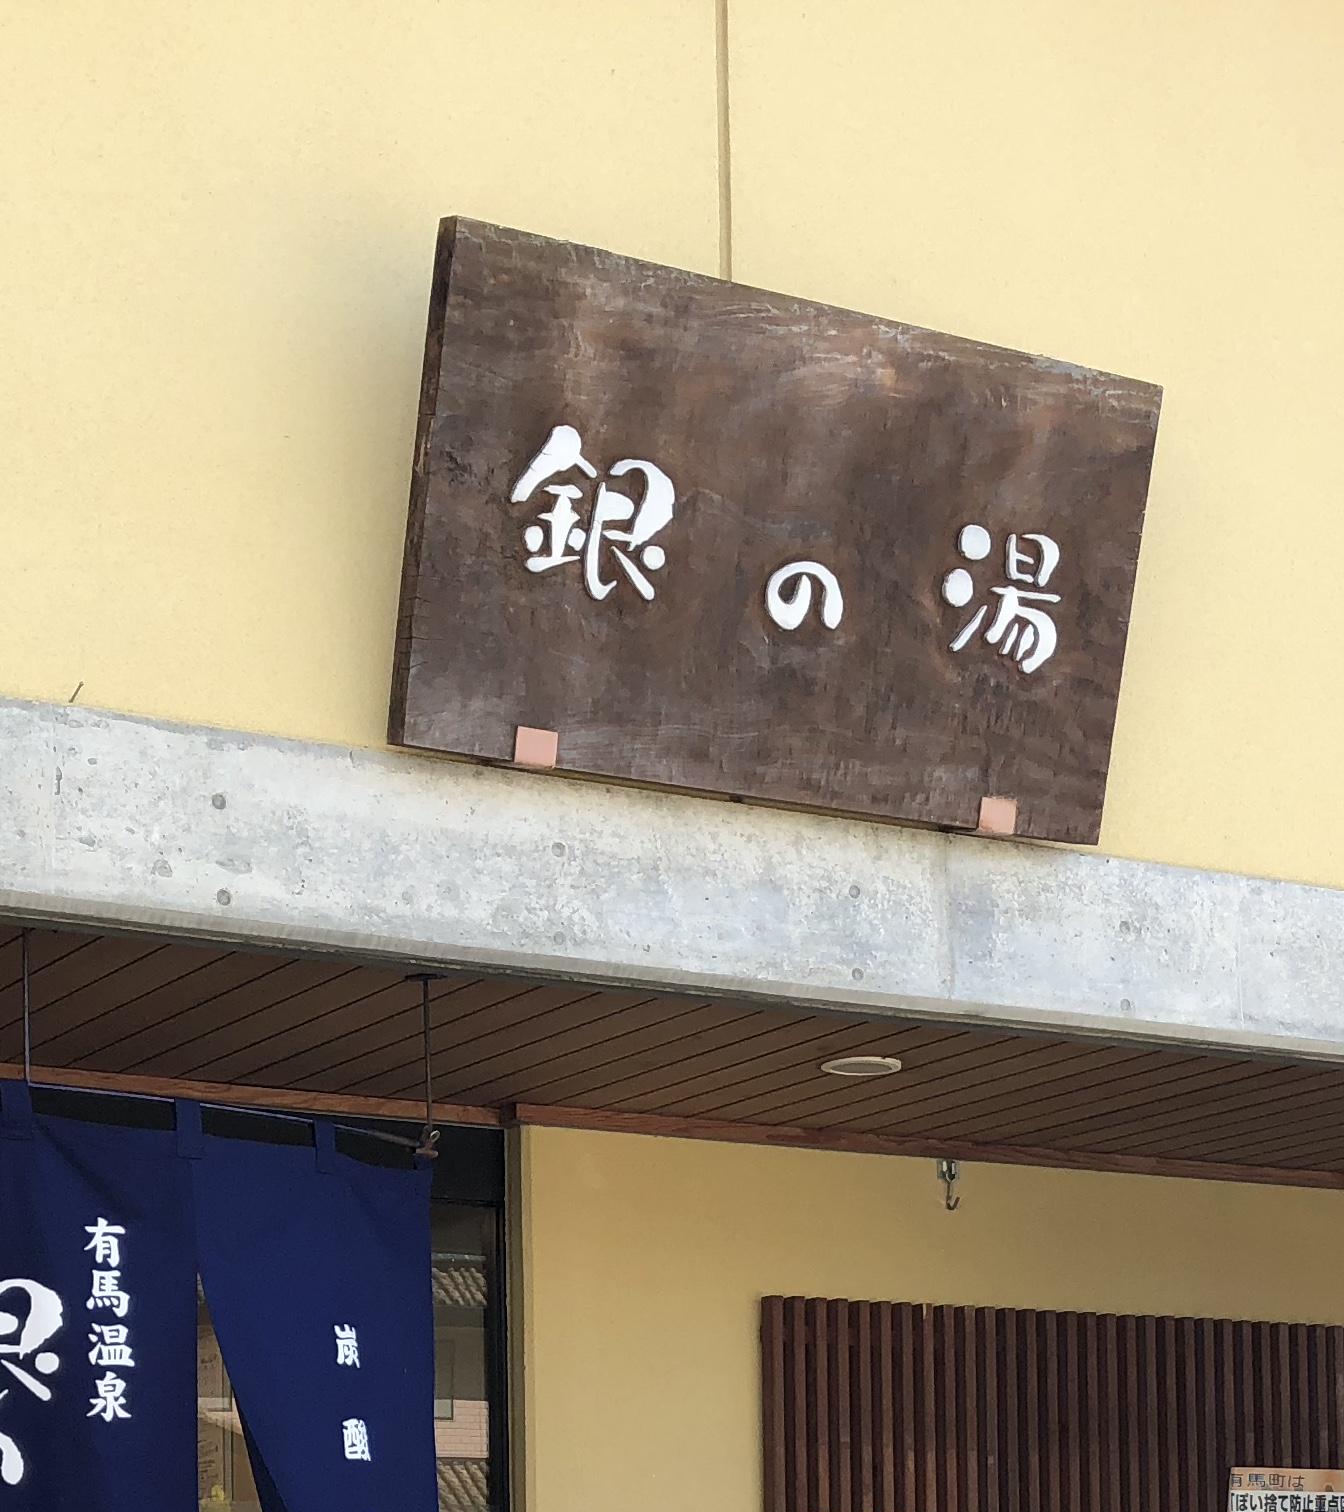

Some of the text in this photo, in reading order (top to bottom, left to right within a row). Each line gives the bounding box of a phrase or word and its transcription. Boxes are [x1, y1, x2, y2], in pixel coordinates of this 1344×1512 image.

[510, 424, 1061, 674] 銀の湯
[83, 1215, 132, 1423] 有馬温泉
